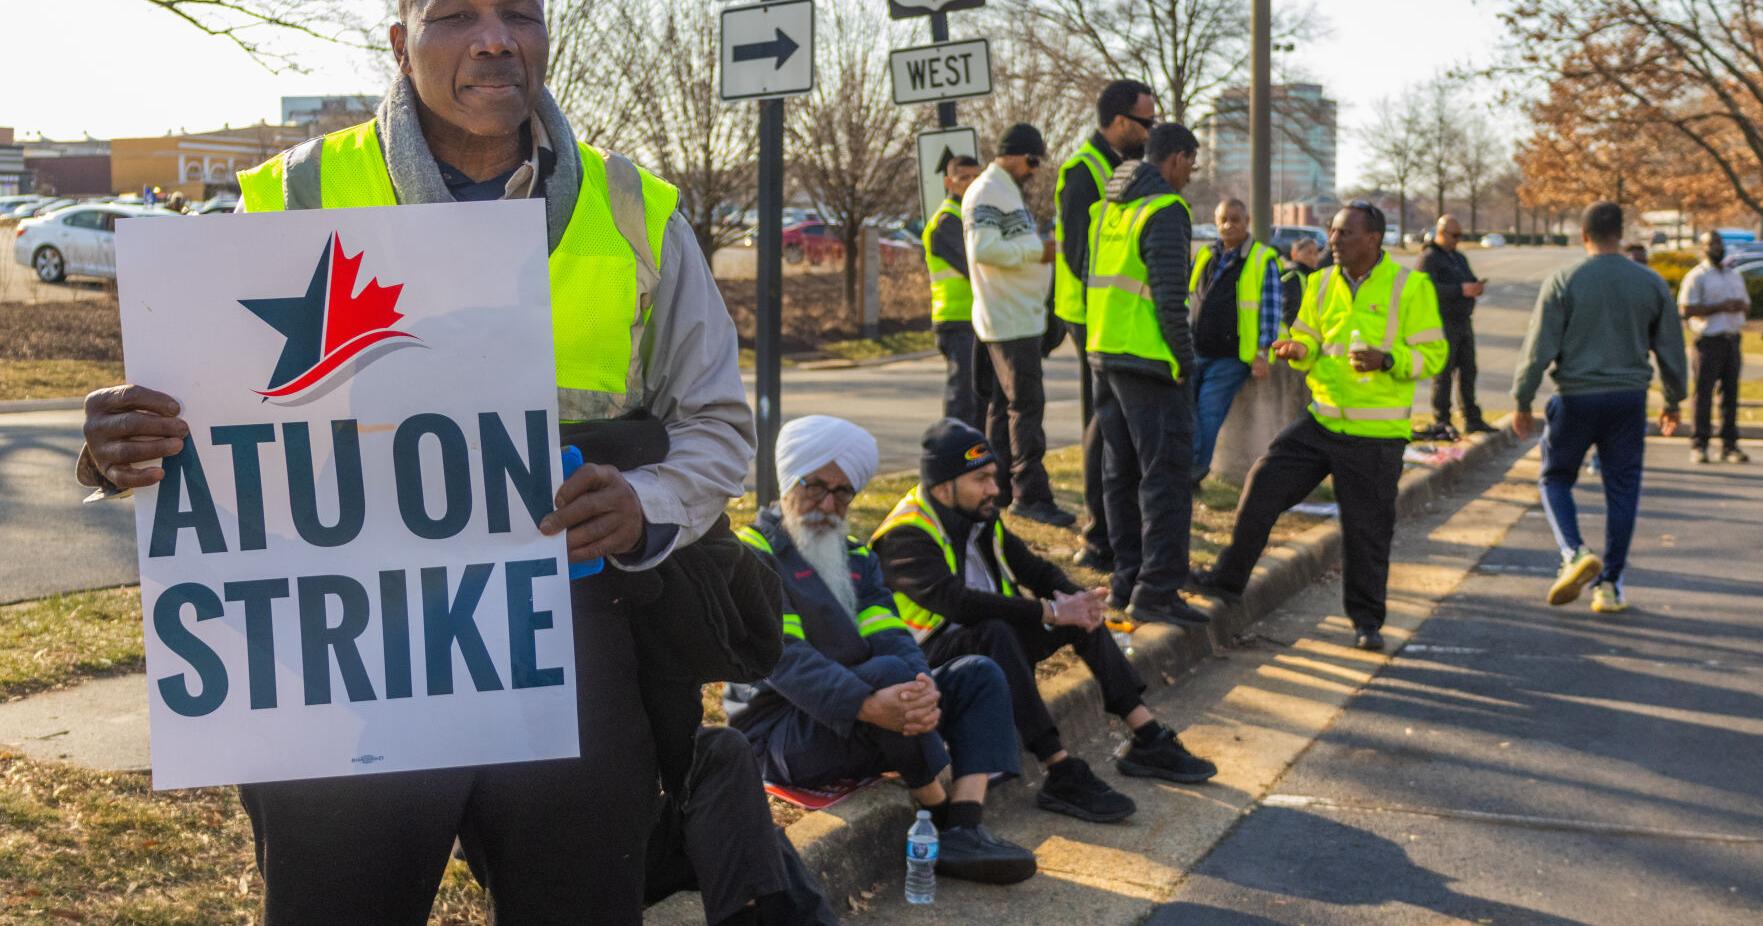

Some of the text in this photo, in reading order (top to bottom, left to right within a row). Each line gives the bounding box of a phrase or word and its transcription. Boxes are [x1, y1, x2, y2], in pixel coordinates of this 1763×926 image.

[907, 53, 972, 91] WEST
[148, 409, 555, 558] ATU ON
[153, 557, 565, 717] STRIKE
